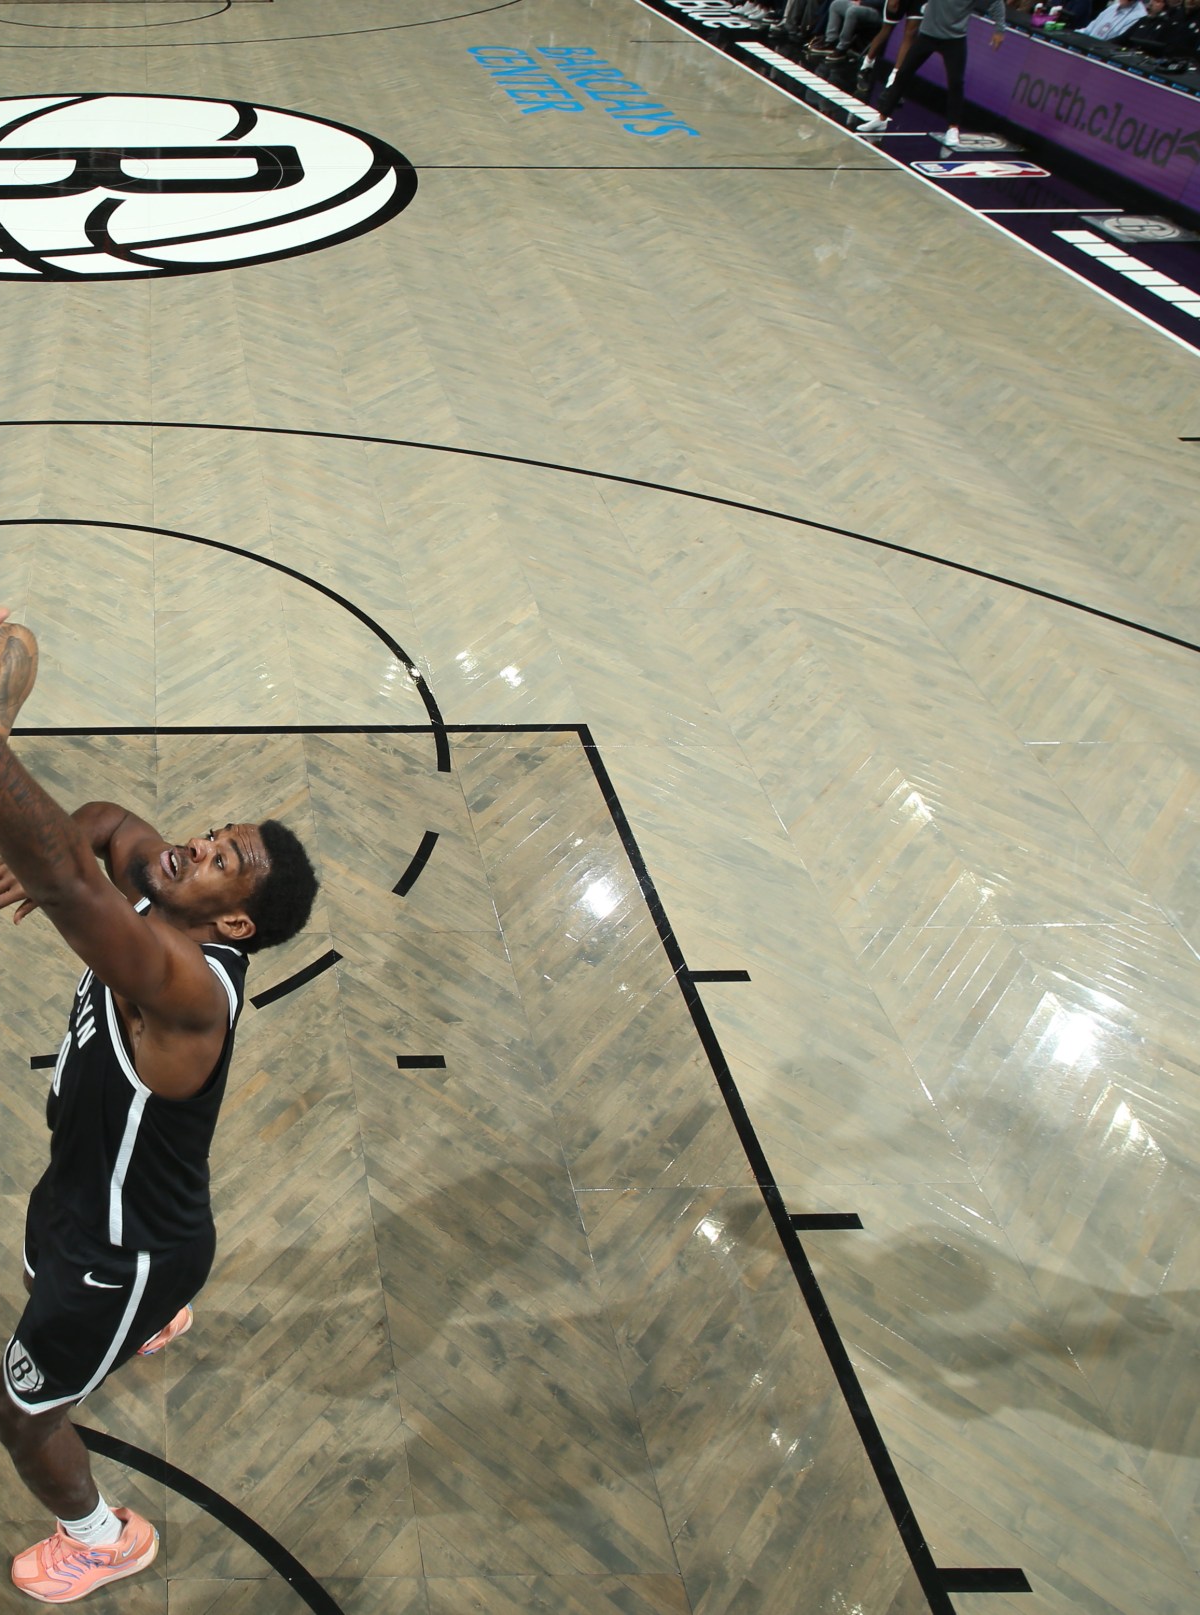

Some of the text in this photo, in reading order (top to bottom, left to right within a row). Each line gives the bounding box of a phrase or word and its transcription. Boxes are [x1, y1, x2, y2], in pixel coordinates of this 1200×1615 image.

[466, 46, 586, 115] CENTER
[536, 46, 701, 137] BARCLAYS
[1010, 69, 1181, 169] north.cloud
